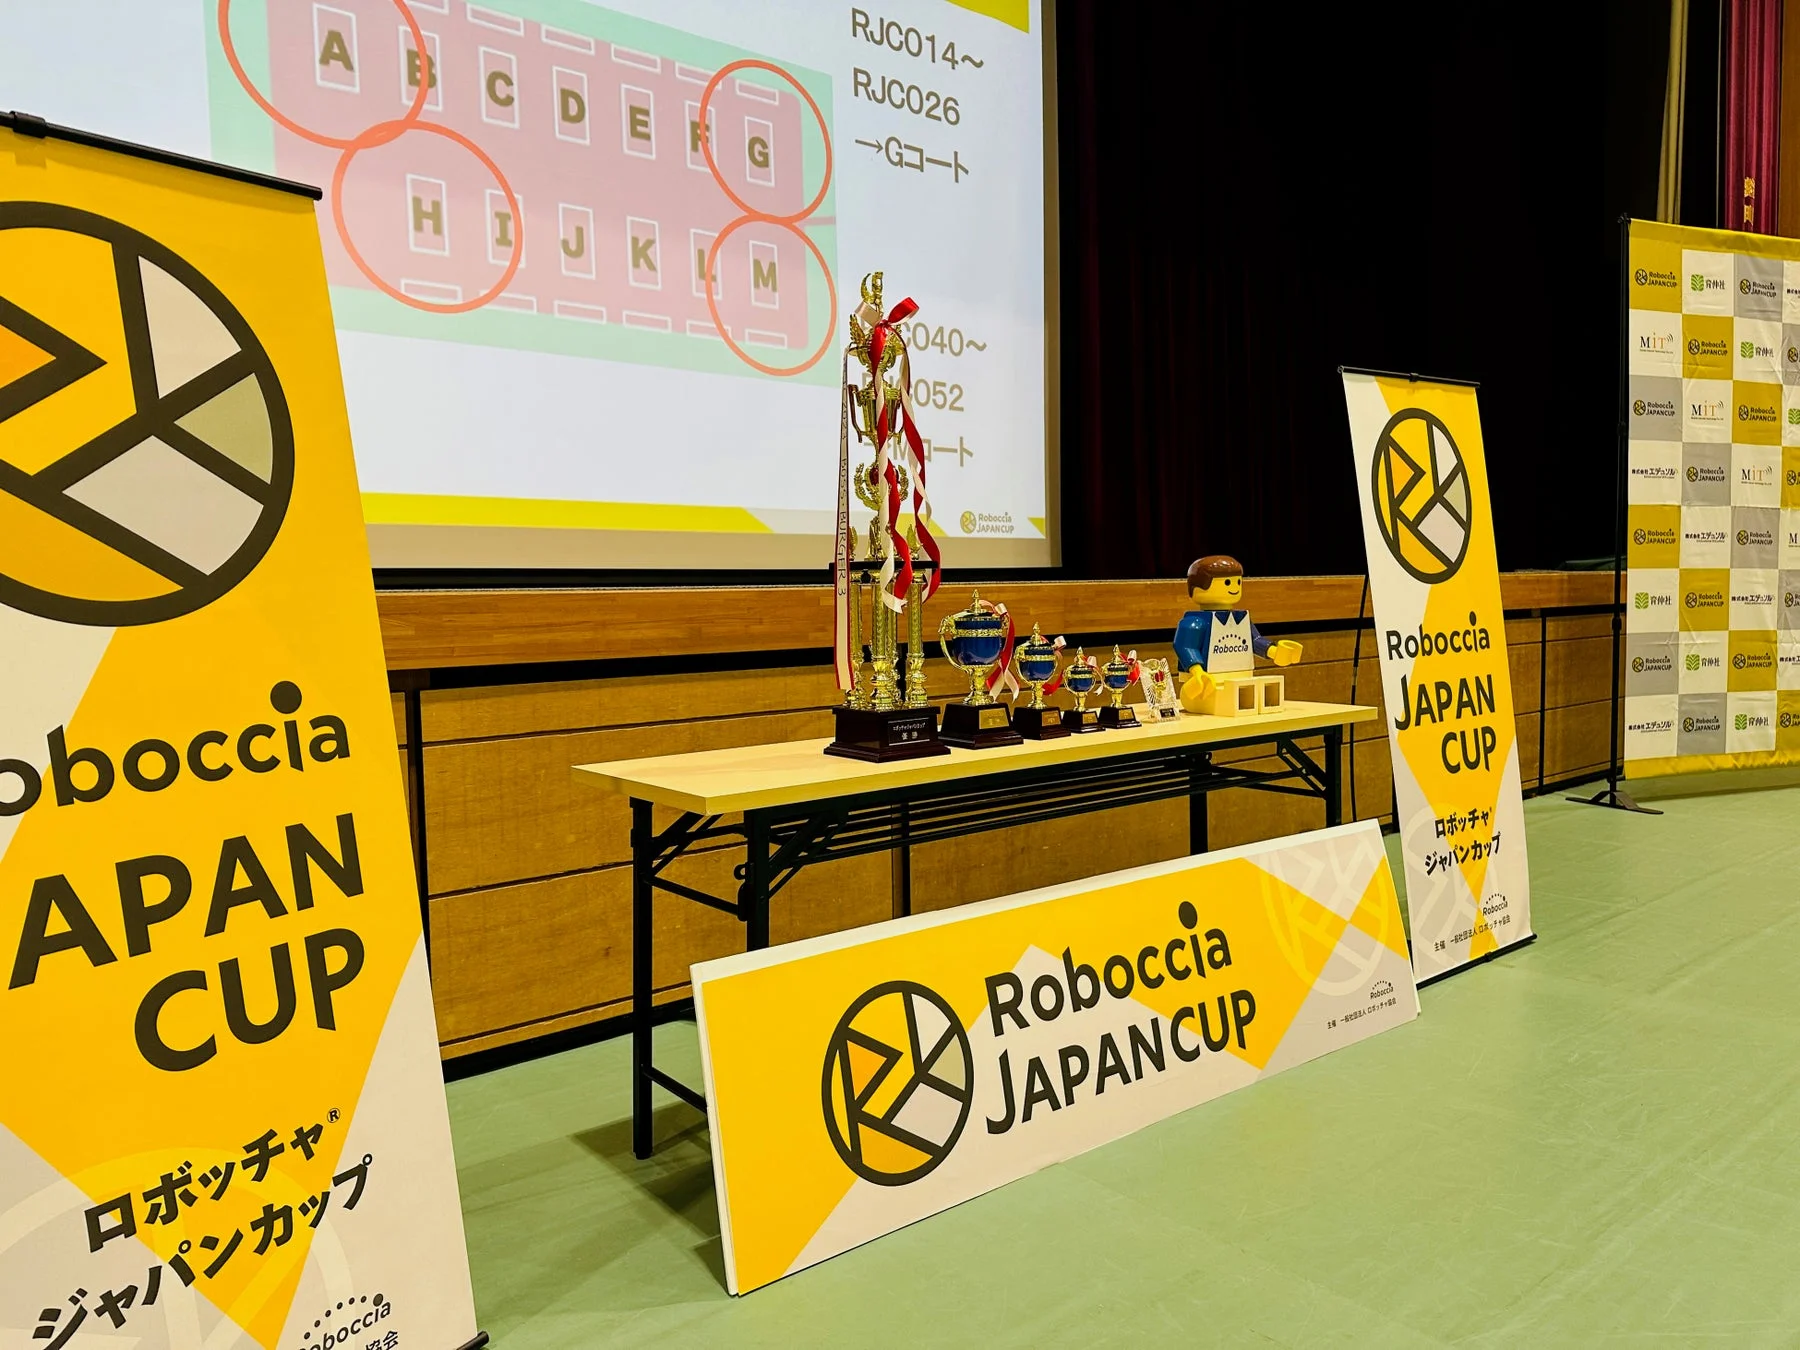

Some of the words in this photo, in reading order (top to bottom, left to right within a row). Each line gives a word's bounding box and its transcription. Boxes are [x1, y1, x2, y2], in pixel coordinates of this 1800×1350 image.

[319, 30, 355, 71] A
[406, 49, 438, 91] B
[486, 70, 515, 107] C
[561, 87, 586, 124] D
[629, 104, 651, 140] E
[690, 118, 710, 153] F
[748, 135, 770, 168] G
[853, 67, 960, 125] RJC026
[413, 197, 442, 236] H
[494, 211, 513, 247] I
[561, 225, 585, 259] J
[631, 237, 657, 272] K
[696, 248, 717, 282] L
[753, 258, 778, 291] M
[1213, 639, 1249, 654] Roboccia
[1386, 611, 1490, 660] Roboccia
[1395, 674, 1496, 731] JAPAN
[1441, 726, 1496, 774] CUP
[1424, 831, 1501, 876] ジャパンカップ
[8, 812, 364, 990] APAN
[1483, 896, 1508, 916] Roboccia
[984, 901, 1232, 1037] Roboccia
[1370, 982, 1394, 999] Roboccia
[134, 928, 365, 1072] CUP
[32, 1153, 373, 1350] ジャパンカップ
